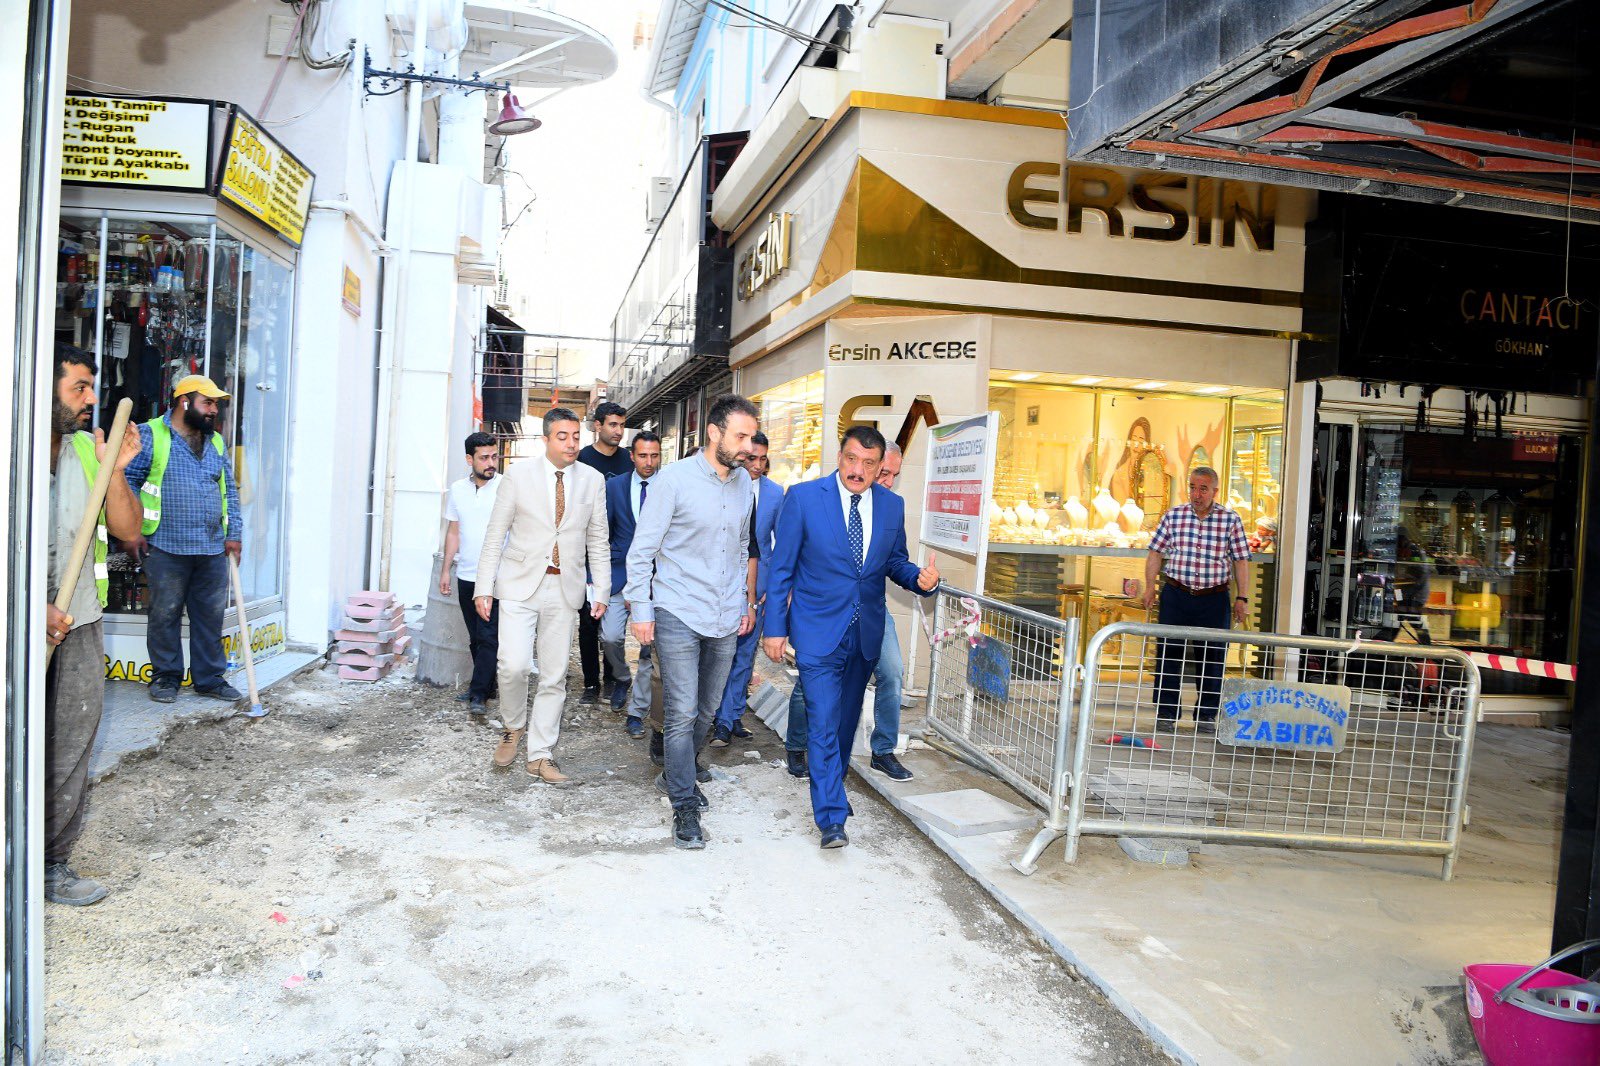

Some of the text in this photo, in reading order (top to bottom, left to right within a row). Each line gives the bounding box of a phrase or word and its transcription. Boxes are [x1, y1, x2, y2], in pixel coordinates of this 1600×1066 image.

[112, 101, 166, 111] Tamiri
[76, 109, 150, 122] Değişimi
[82, 134, 136, 144] Nubuk
[231, 117, 272, 175] LOSTRA
[114, 146, 182, 158] boyanır.
[64, 155, 189, 170] Türlü Ayakkabı
[90, 170, 148, 179] yapılır.
[226, 151, 270, 205] SALONU
[828, 341, 977, 361] Ersin AKCEBE
[1495, 337, 1544, 357] GÖKHAN
[1234, 719, 1334, 747] ZABITA
